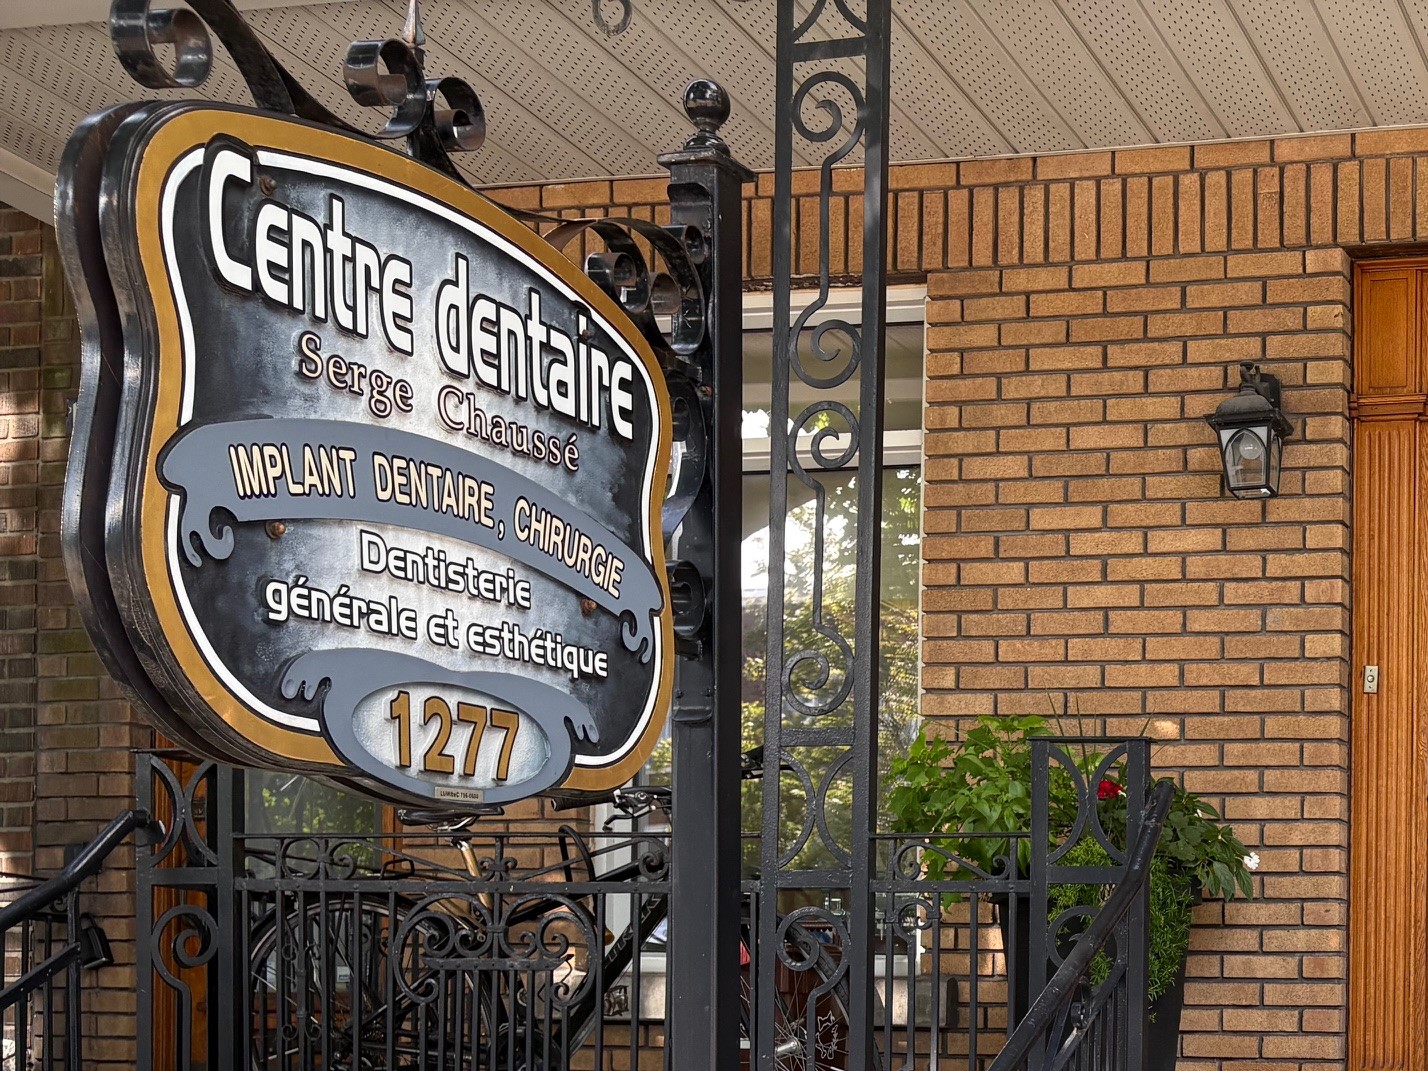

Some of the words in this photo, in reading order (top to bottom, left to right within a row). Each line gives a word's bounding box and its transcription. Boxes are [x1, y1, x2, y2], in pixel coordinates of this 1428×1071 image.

[209, 148, 413, 356] Centre
[437, 256, 634, 440] dentaire
[300, 332, 413, 416] Serge
[437, 386, 580, 471] Chaussé
[229, 443, 357, 499] IMPLANT
[514, 499, 625, 600] CHIRURGIE
[361, 531, 532, 609] Dentisterie
[265, 576, 418, 640] générale
[428, 611, 461, 648] et
[469, 621, 608, 679] esthétique
[390, 690, 519, 781] 1277
